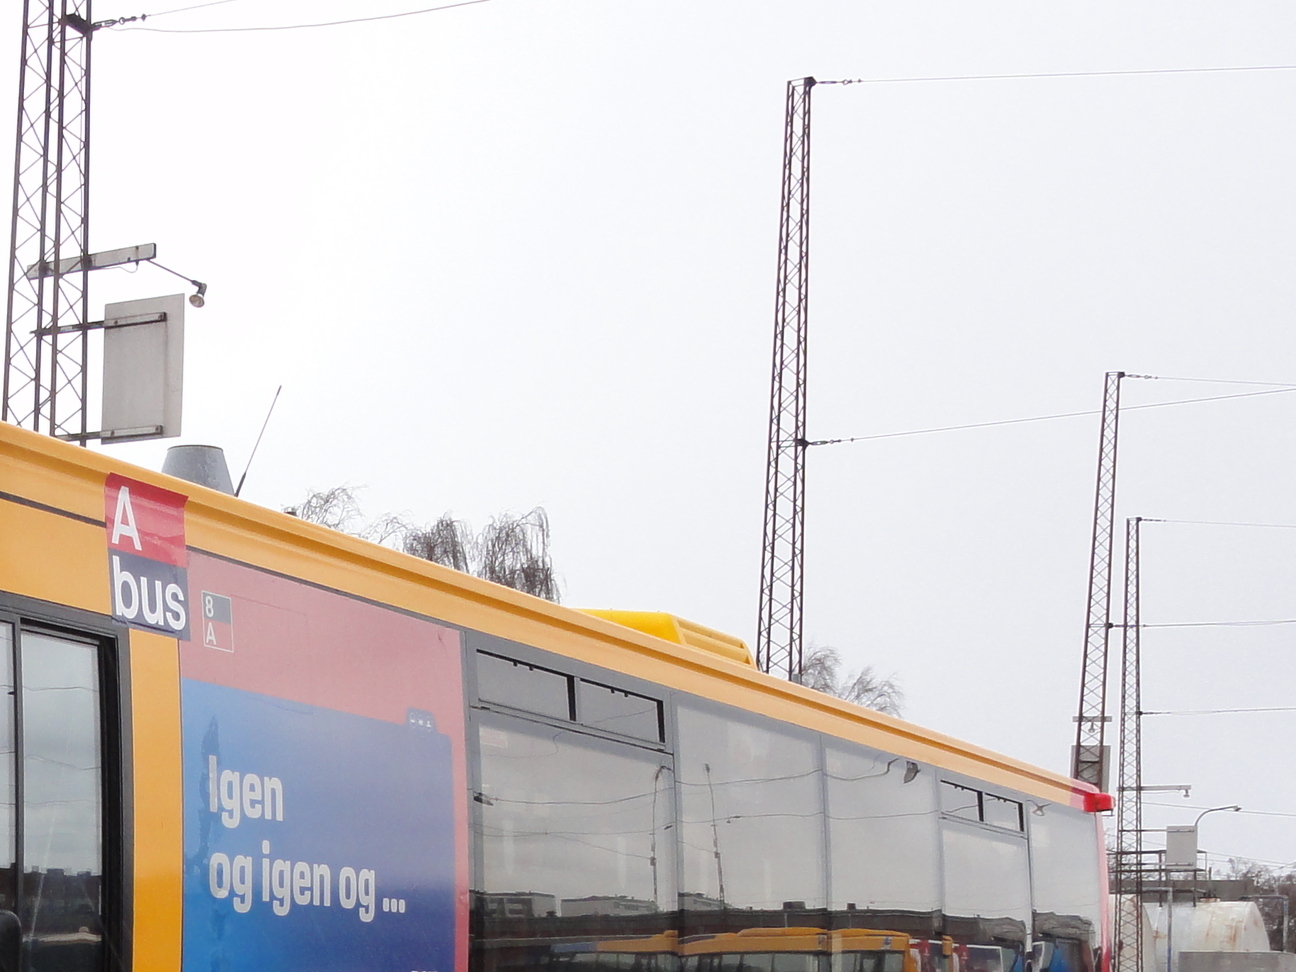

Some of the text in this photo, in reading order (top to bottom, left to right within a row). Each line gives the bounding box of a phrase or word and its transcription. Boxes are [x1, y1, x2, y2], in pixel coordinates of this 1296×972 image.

[111, 486, 143, 551] A
[112, 555, 187, 631] bus
[205, 623, 217, 645] A
[208, 754, 284, 829] Igen
[208, 852, 253, 913] og
[261, 839, 331, 917] igen
